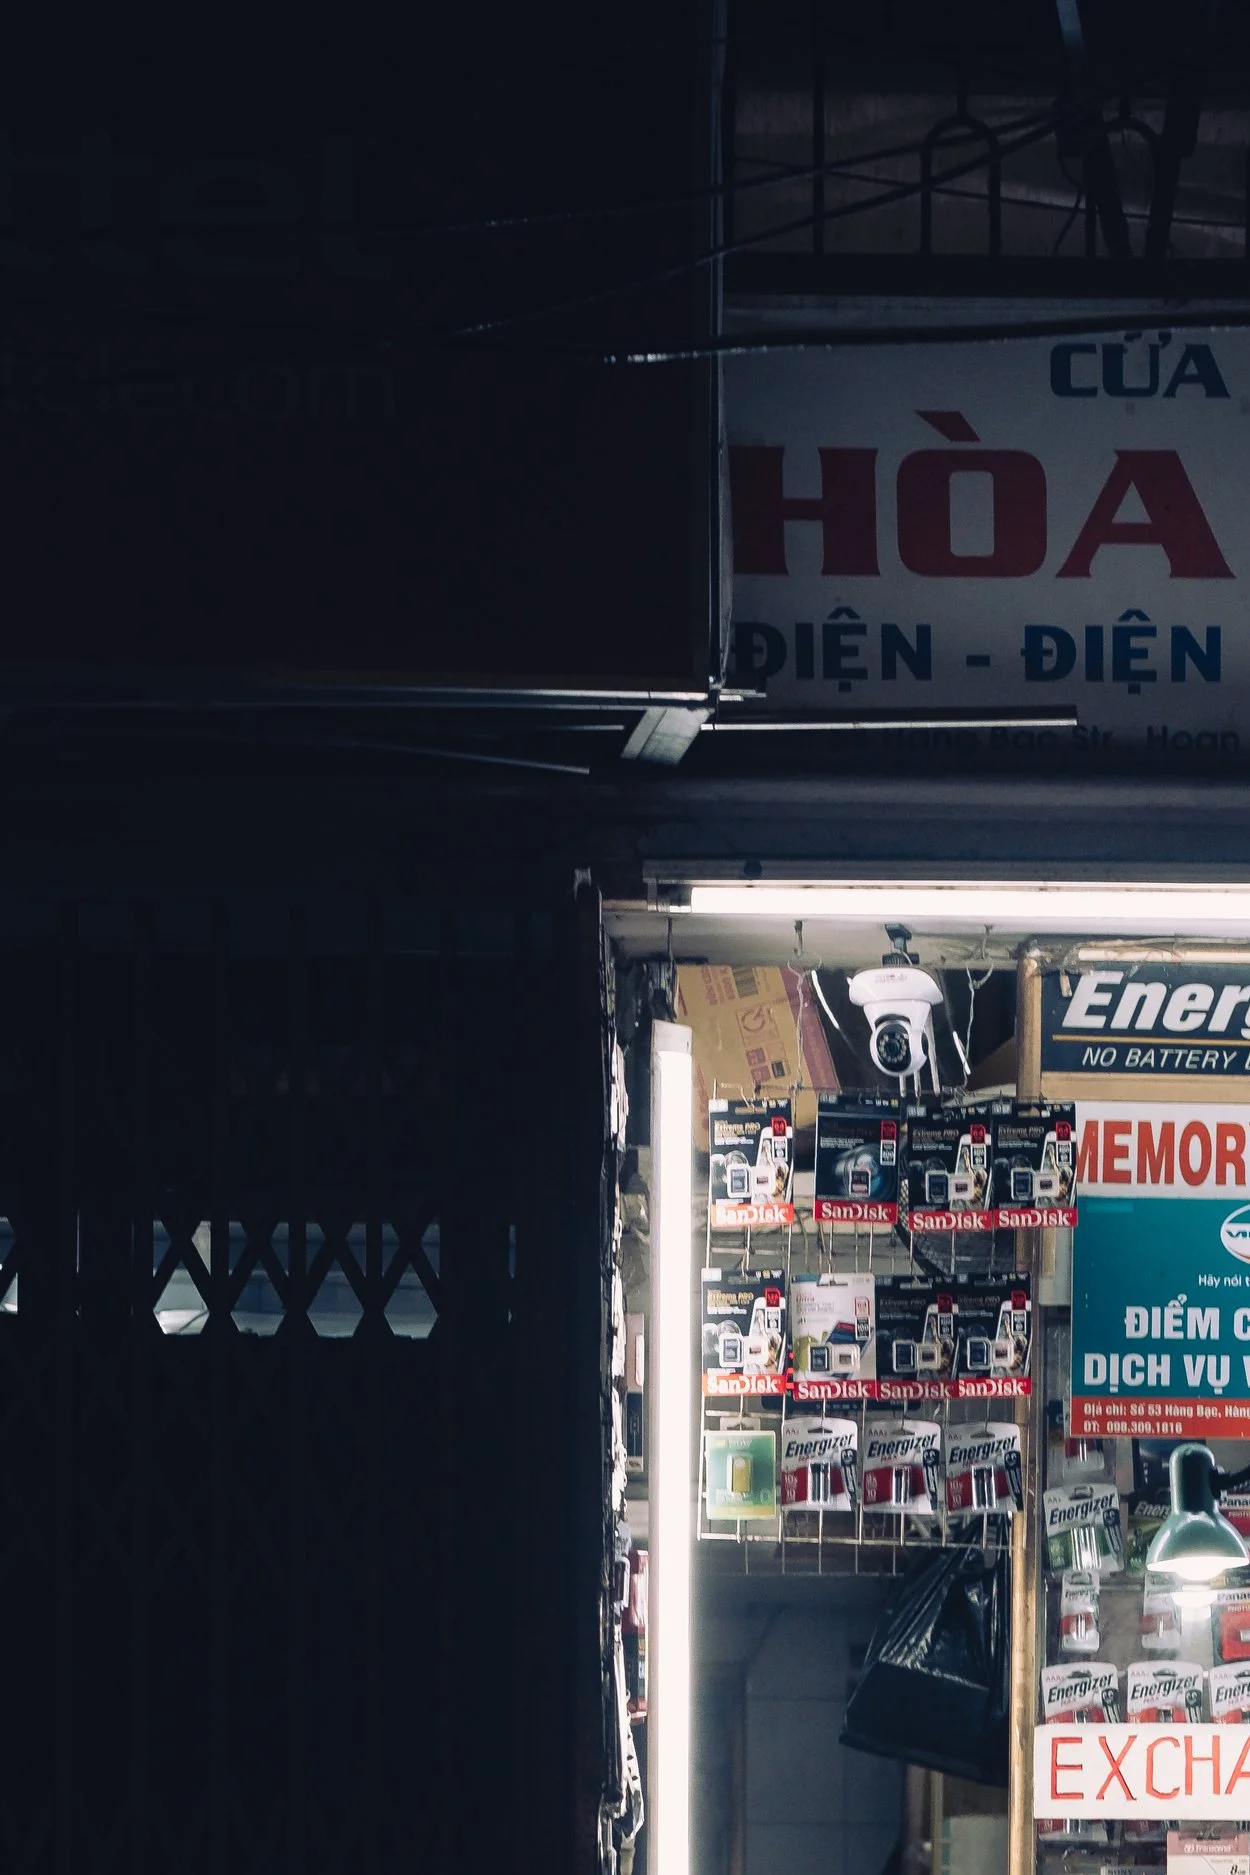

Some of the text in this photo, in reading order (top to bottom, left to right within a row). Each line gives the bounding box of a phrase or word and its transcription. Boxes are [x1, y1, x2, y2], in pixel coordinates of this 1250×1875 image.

[727, 410, 1236, 579] HÒA
[729, 606, 932, 693] ĐIỆN
[1021, 609, 1222, 695] ĐIỆN
[1146, 725, 1240, 754] Hoan
[1082, 1047, 1117, 1067] NO
[1125, 1048, 1238, 1071] BATTERY
[715, 1204, 786, 1224] SanDisk
[821, 1202, 890, 1222] SanDisk
[913, 1211, 985, 1230] SanDisk
[999, 1209, 1070, 1227] SanDisk
[1124, 1293, 1221, 1341] ĐIỂM
[707, 1374, 779, 1394] SanDisk
[1083, 1353, 1169, 1394] DỊCH
[1183, 1354, 1231, 1395] VỤ
[798, 1381, 871, 1399] SanDisk
[880, 1383, 953, 1400] SanDisk
[958, 1379, 1024, 1396] SanDisk
[785, 1434, 853, 1459] Energizer
[867, 1434, 937, 1459] Energizer
[948, 1436, 1017, 1465] Energizer
[1048, 1493, 1116, 1526] Energizer
[1047, 1673, 1113, 1704] Energizer
[1130, 1674, 1199, 1701] Energizer
